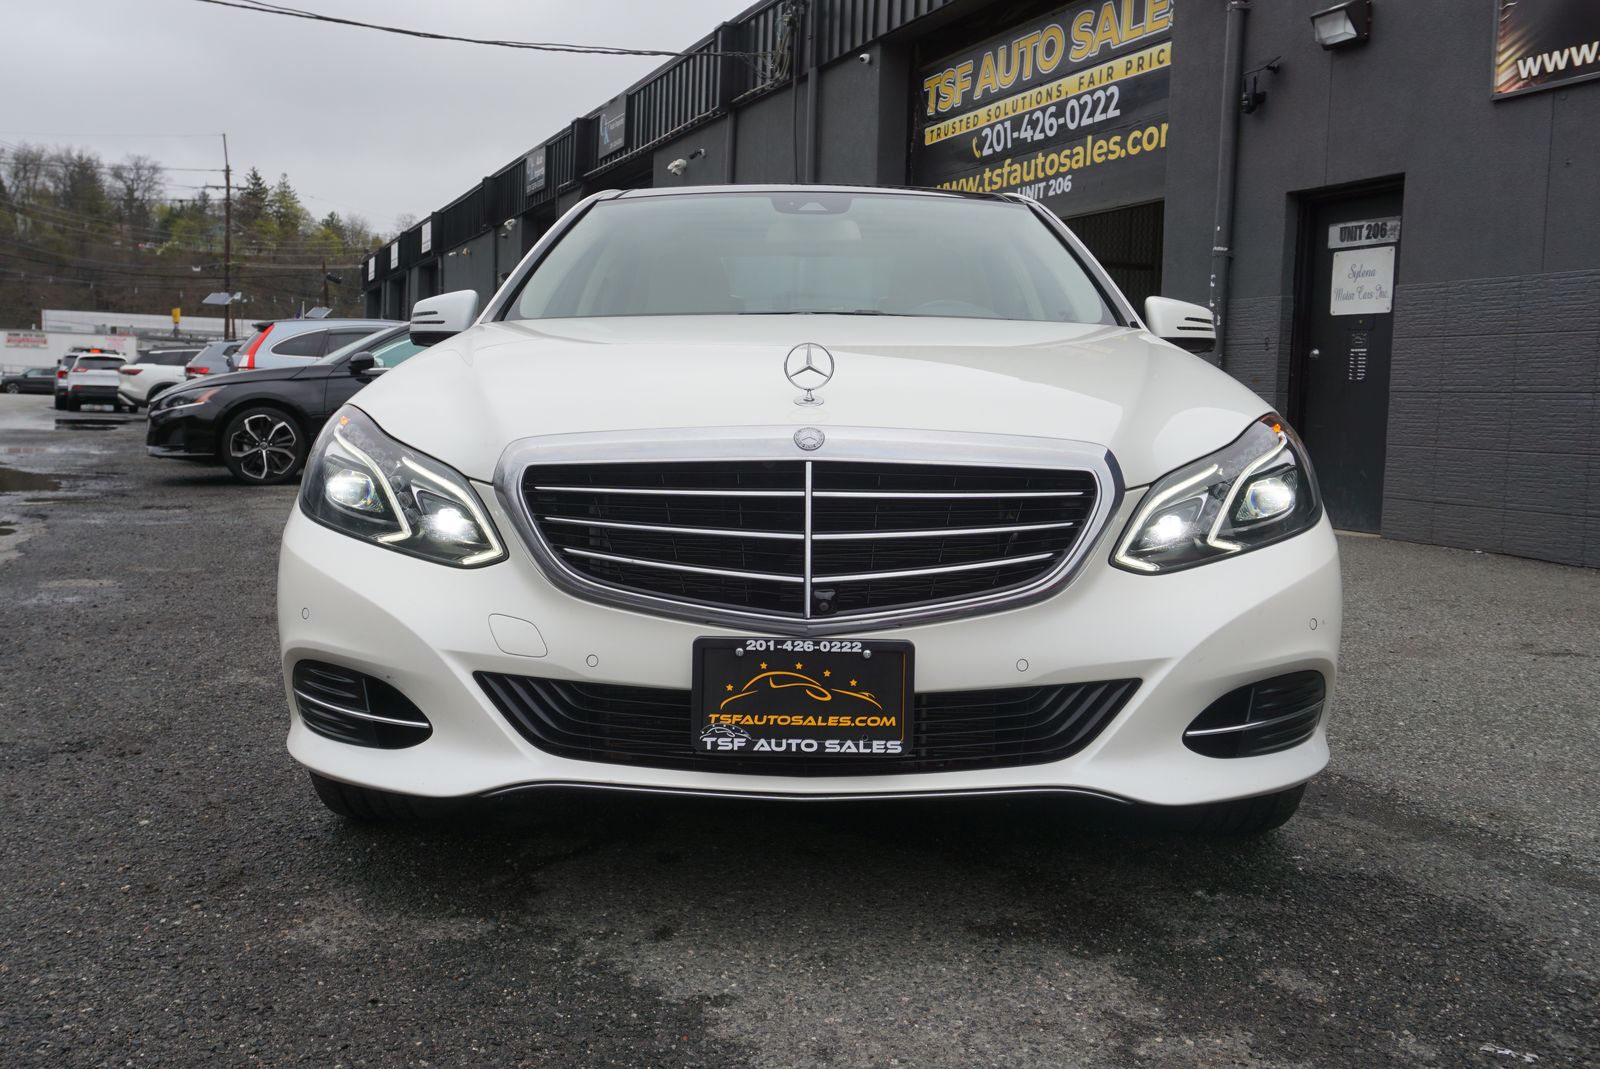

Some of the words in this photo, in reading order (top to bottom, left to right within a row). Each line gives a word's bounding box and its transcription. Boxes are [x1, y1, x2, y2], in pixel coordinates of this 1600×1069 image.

[924, 60, 973, 116] TSF
[974, 23, 1065, 100] AUTO
[1069, 0, 1173, 63] SALE
[929, 113, 979, 144] TRUSTED
[986, 84, 1069, 121] SOLUTIONS,
[1078, 65, 1114, 92] FAIR
[981, 85, 1120, 157] 201-426-0222
[936, 122, 1168, 193] ww.tsfautosales.co
[1048, 175, 1072, 196] 206
[1340, 224, 1364, 242] UNIT
[1365, 222, 1388, 240] 206
[746, 640, 862, 652] 201-426-0222
[708, 713, 896, 727] TSFAUTOSALES.COM
[702, 737, 747, 751] TSF
[752, 738, 818, 752] AUTO
[824, 740, 903, 753] SALES
